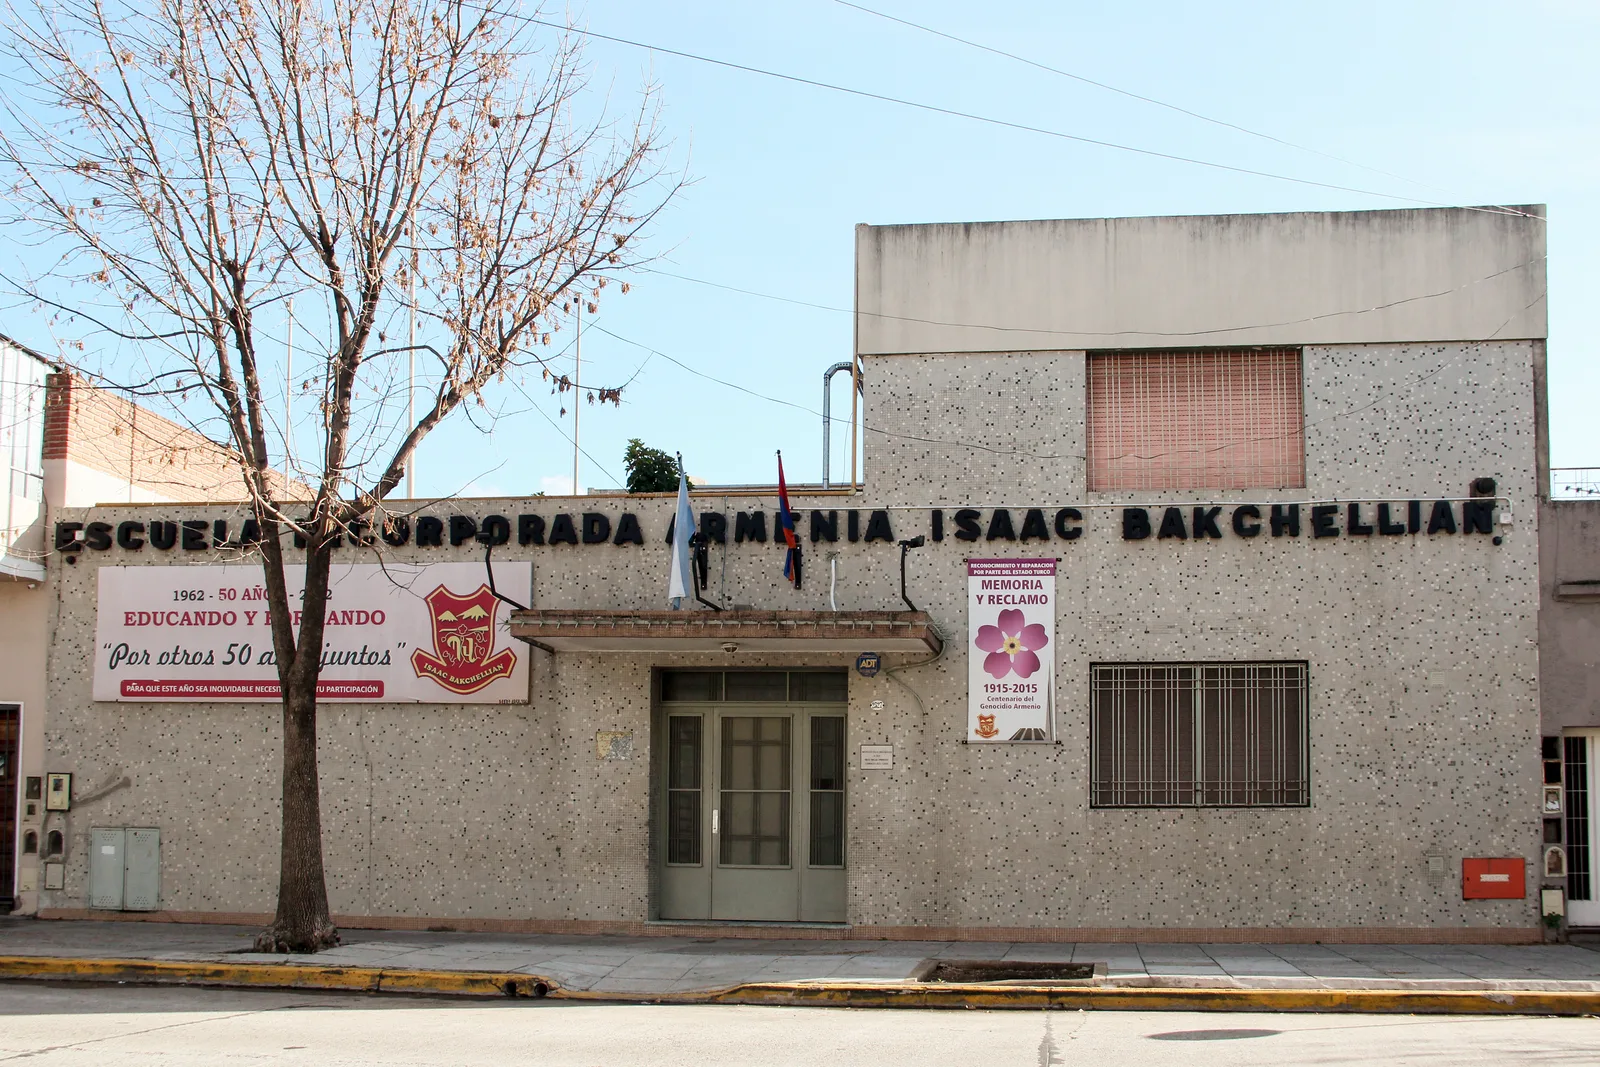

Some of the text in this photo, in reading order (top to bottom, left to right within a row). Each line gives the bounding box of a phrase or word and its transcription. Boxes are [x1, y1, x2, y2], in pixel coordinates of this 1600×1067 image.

[932, 508, 1082, 541] ISAAC
[1123, 501, 1494, 541] BAKCHELLIAN
[981, 580, 1044, 590] MEMORIA
[173, 590, 205, 601] 1962
[218, 588, 237, 601] 50
[976, 594, 1049, 605] Y RECLAMO
[123, 610, 238, 627] EDUCANDO
[244, 610, 258, 626] Y
[157, 644, 215, 666] otros
[222, 642, 252, 666] 50
[859, 659, 877, 668] ADT
[423, 662, 504, 685] ISAAC BAKCHELLIAN
[126, 685, 145, 693] PARA
[145, 685, 161, 693] QUE
[161, 685, 178, 693] ESTE
[178, 683, 195, 693] AÑO
[195, 685, 209, 693] SEA
[209, 685, 254, 693] INOLVIDABLE
[326, 684, 379, 693] PARTICIPACIÓN
[983, 683, 1038, 693] 1915-2015
